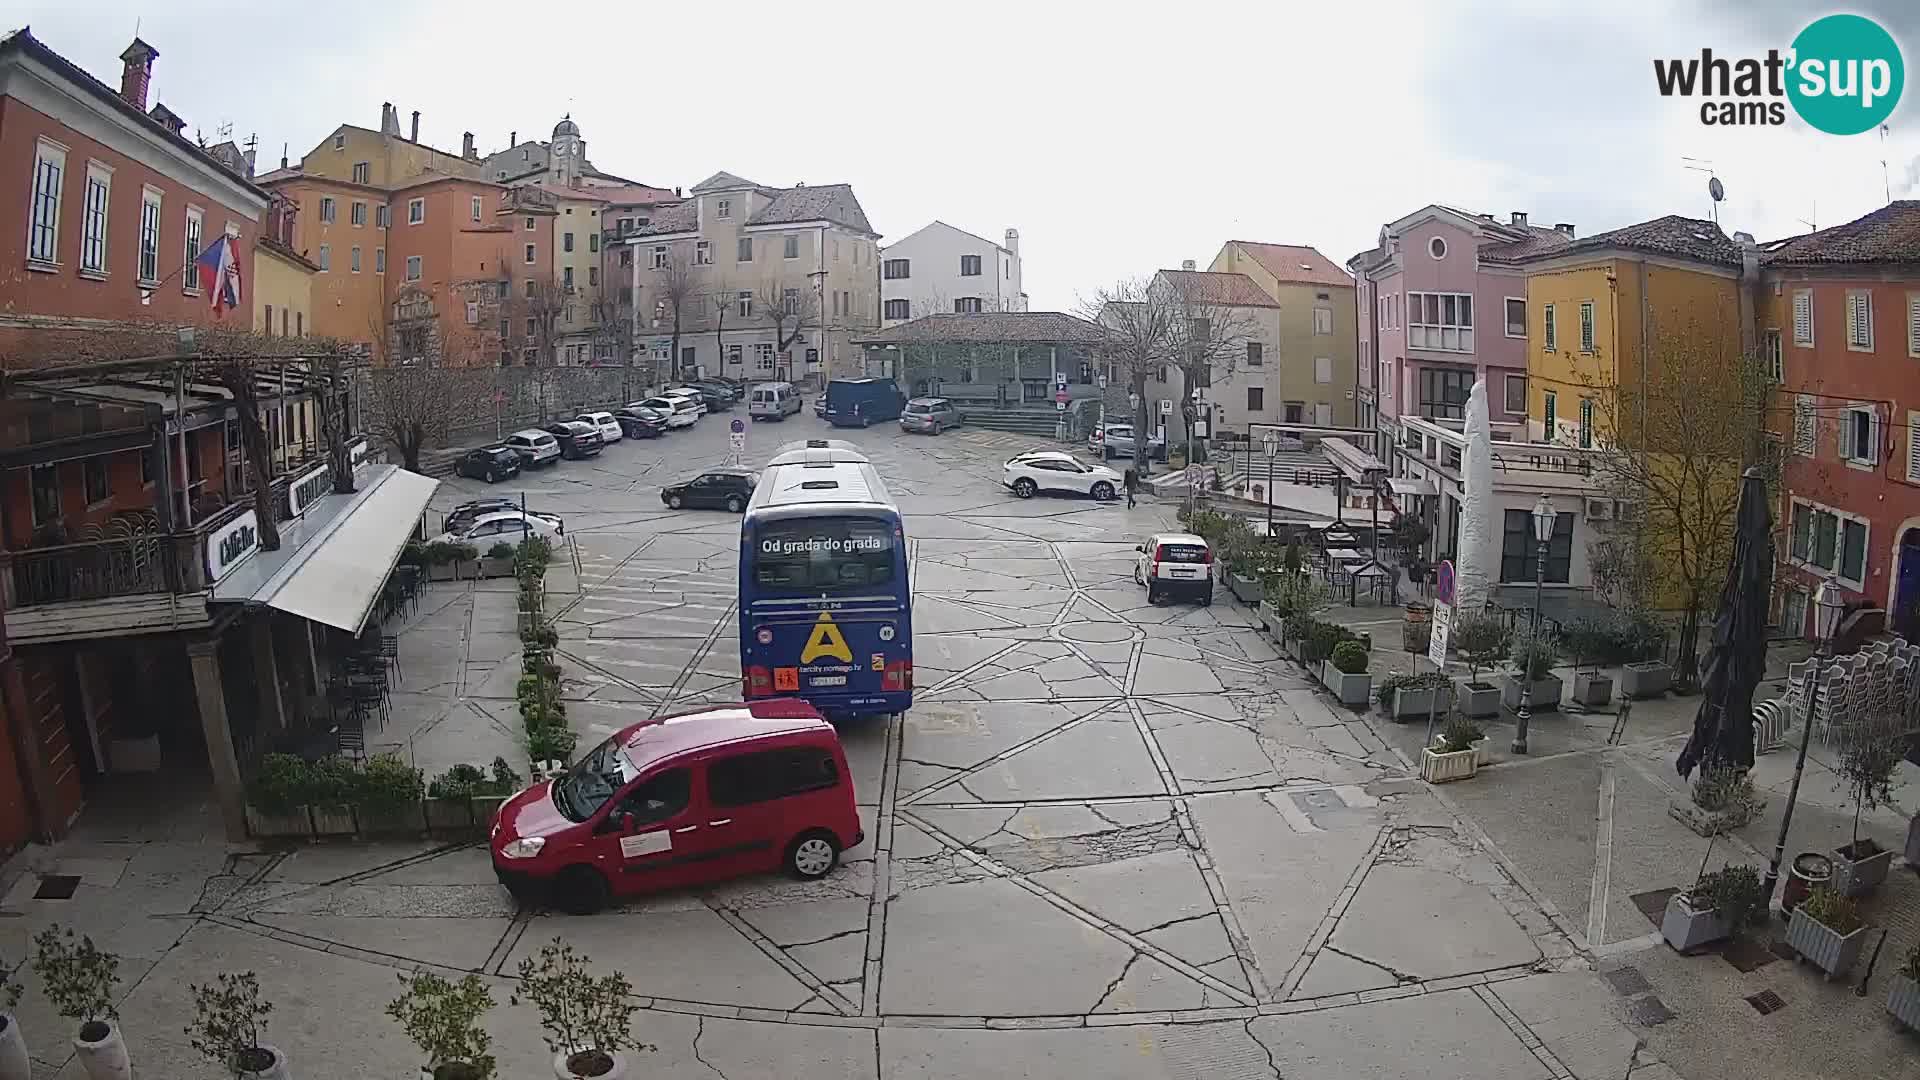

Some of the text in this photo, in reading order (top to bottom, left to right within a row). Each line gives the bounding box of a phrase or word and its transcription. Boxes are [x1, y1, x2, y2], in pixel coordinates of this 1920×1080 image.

[762, 536, 881, 554] Od grada do grada
